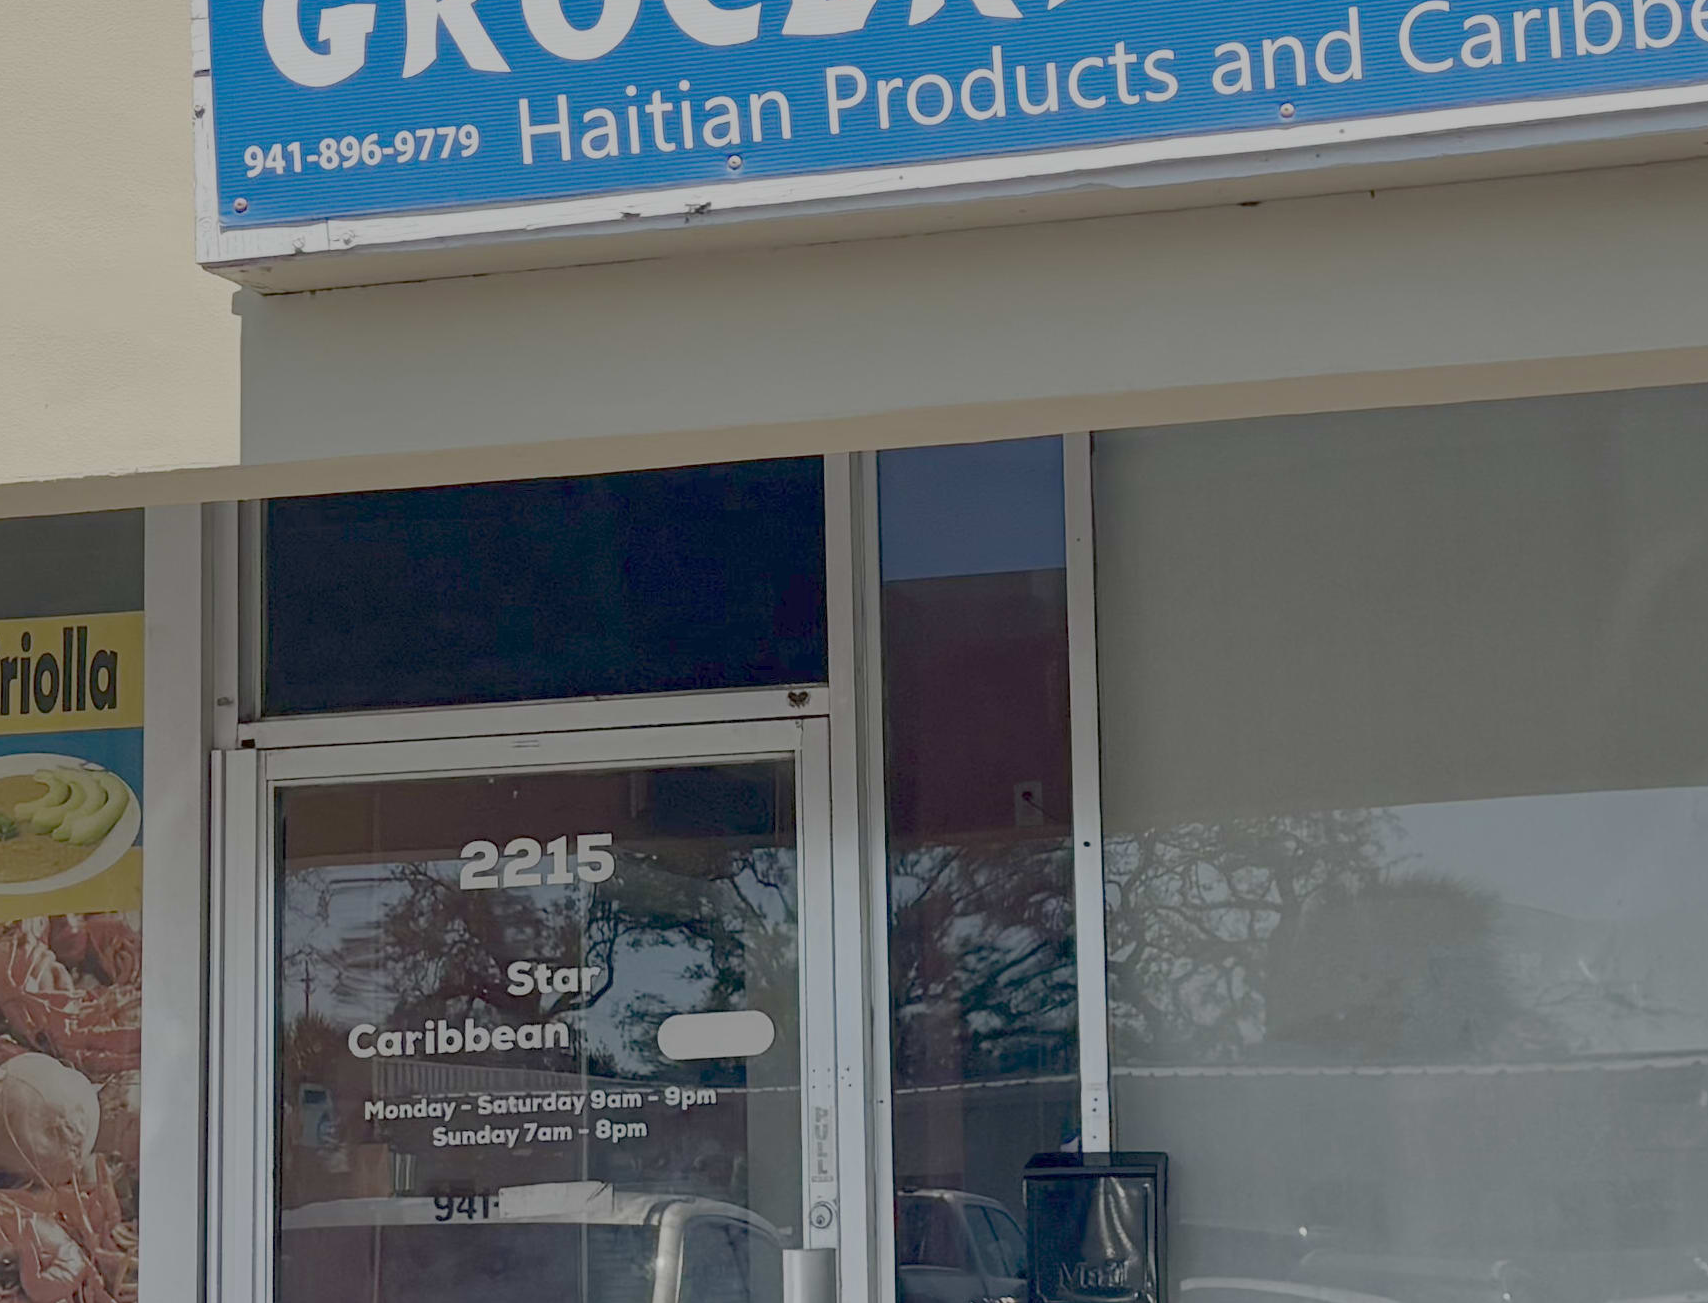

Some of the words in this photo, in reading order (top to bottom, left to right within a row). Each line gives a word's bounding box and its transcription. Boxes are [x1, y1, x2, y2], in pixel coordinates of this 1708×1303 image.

[518, 80, 792, 164] Haitian
[826, 46, 1179, 135] Products
[1212, 7, 1364, 88] and
[244, 124, 480, 177] 941-896-9779
[459, 833, 615, 890] 2215
[507, 961, 600, 996] Star
[348, 1018, 570, 1058] Caribbean
[365, 1099, 456, 1121] Monday
[478, 1093, 585, 1116] Saturday
[591, 1090, 642, 1109] 9am
[665, 1086, 717, 1110] 9pm
[433, 1124, 519, 1148] Sunday
[523, 1122, 572, 1142] 7am
[595, 1119, 647, 1143] 8pm
